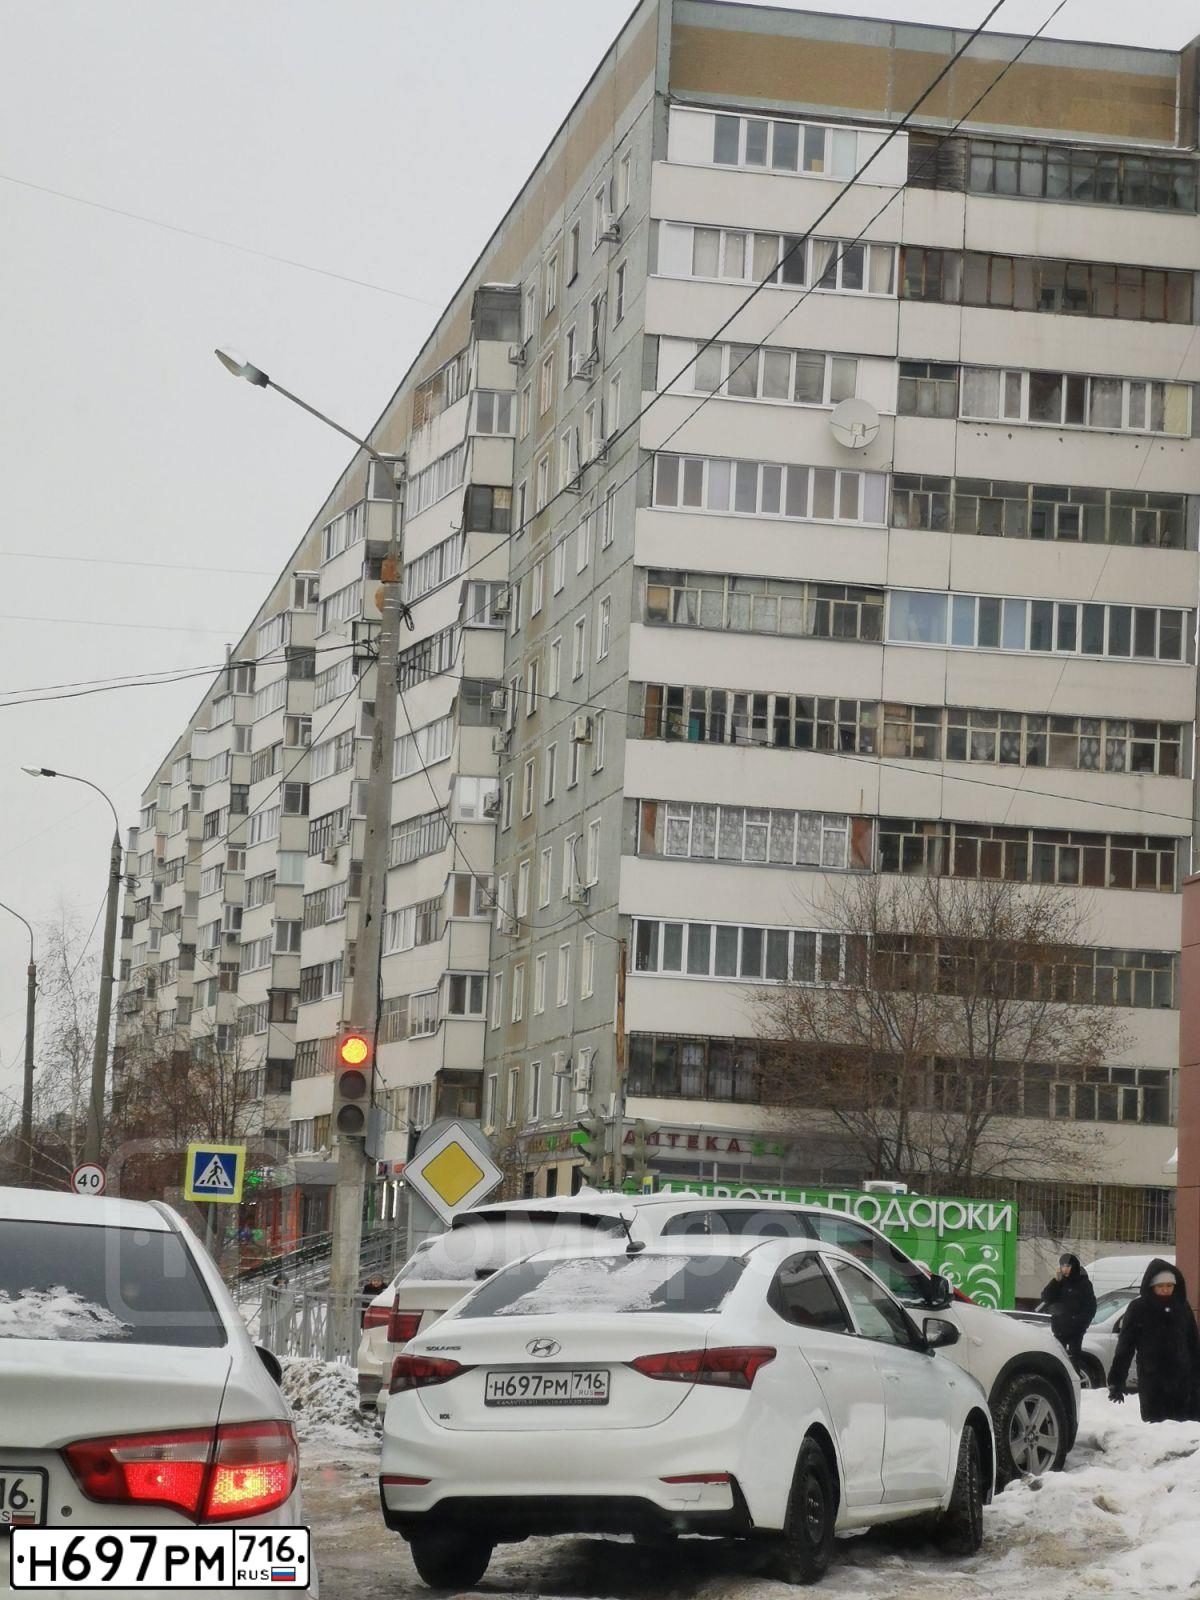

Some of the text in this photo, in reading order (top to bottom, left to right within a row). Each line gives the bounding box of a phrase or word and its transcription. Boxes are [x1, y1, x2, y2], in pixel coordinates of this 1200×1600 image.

[623, 1130, 742, 1154] АПТЕКА
[77, 1173, 100, 1188] 40
[493, 1373, 604, 1397] Н697РМ 716
